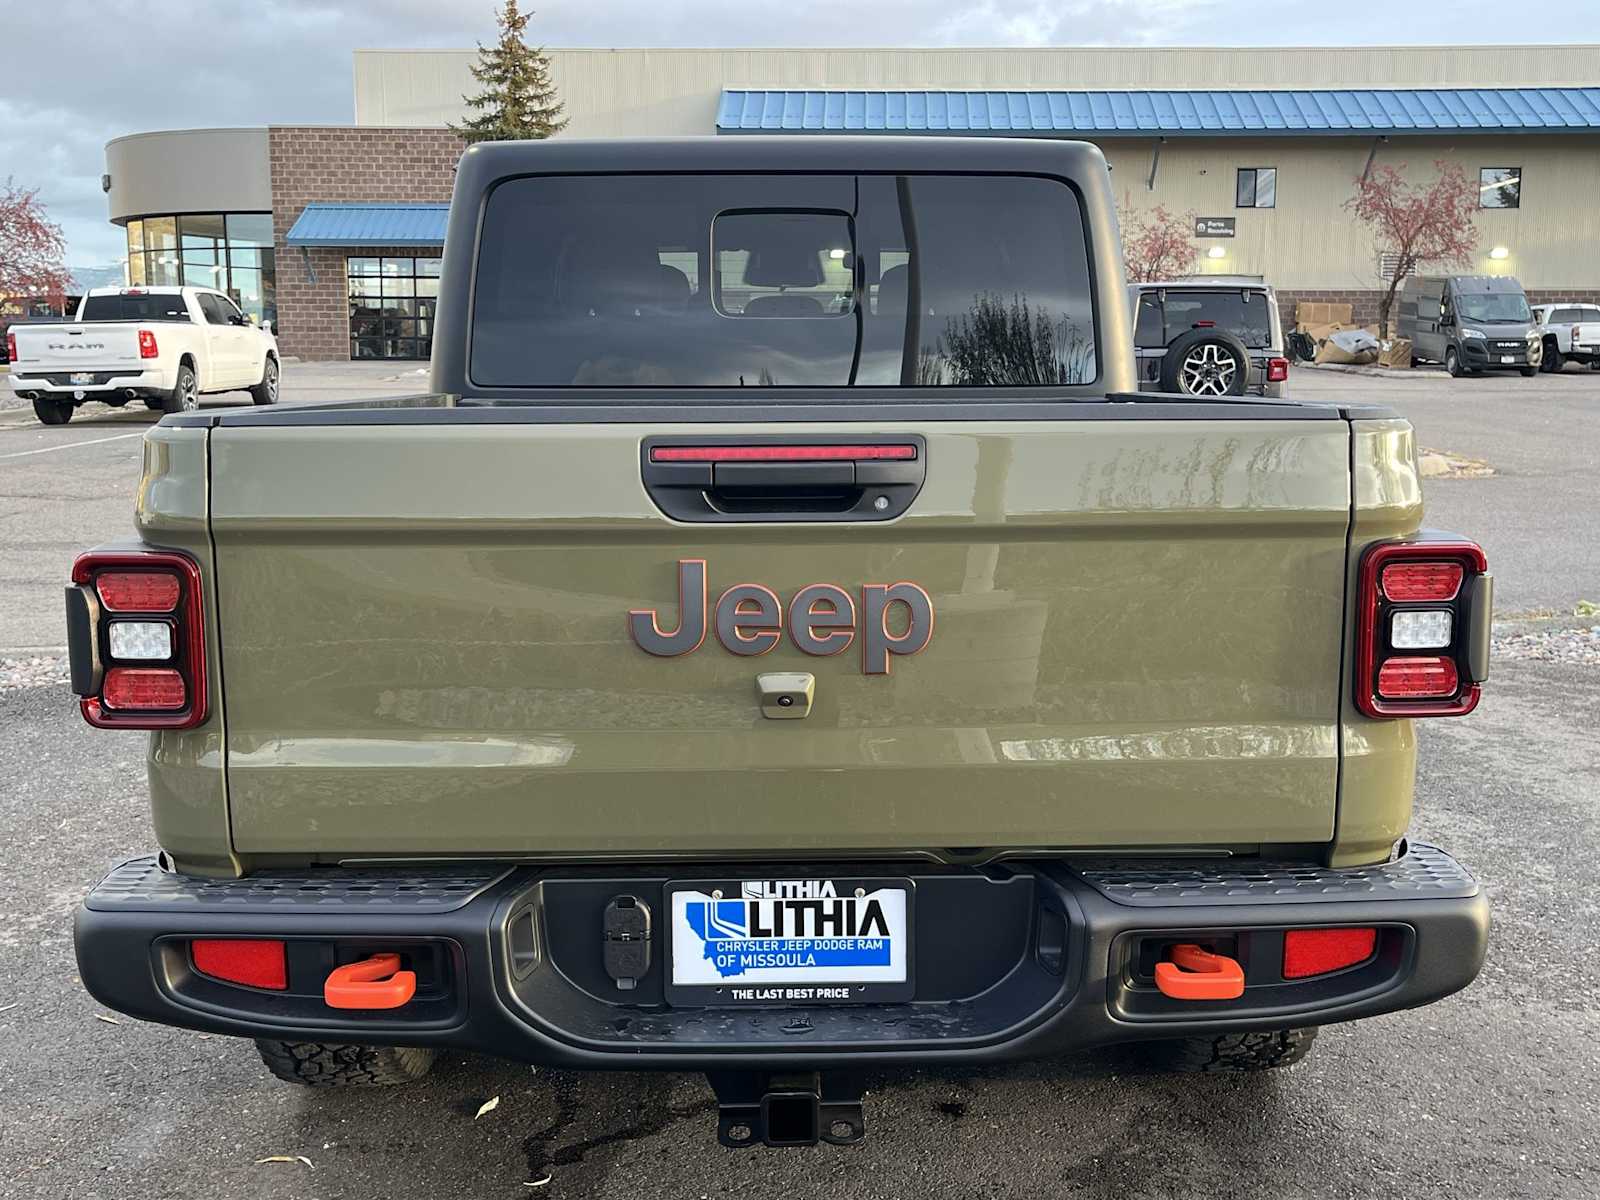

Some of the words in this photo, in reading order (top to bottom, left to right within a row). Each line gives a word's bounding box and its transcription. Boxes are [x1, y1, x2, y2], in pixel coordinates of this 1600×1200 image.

[48, 342, 105, 350] RAM
[629, 558, 935, 675] Jeep
[763, 880, 837, 898] LITHIA
[749, 900, 890, 938] LITHIA
[716, 940, 779, 952] CHRYSLER
[781, 940, 812, 951] JEEP
[814, 939, 855, 951] DODGE
[857, 939, 884, 950] RAM
[716, 954, 737, 968] OF
[740, 953, 816, 967] MISSOULA
[732, 989, 754, 1000] THE
[756, 988, 785, 1000] LAST
[786, 988, 815, 999] BEST
[816, 987, 850, 999] PRICE
